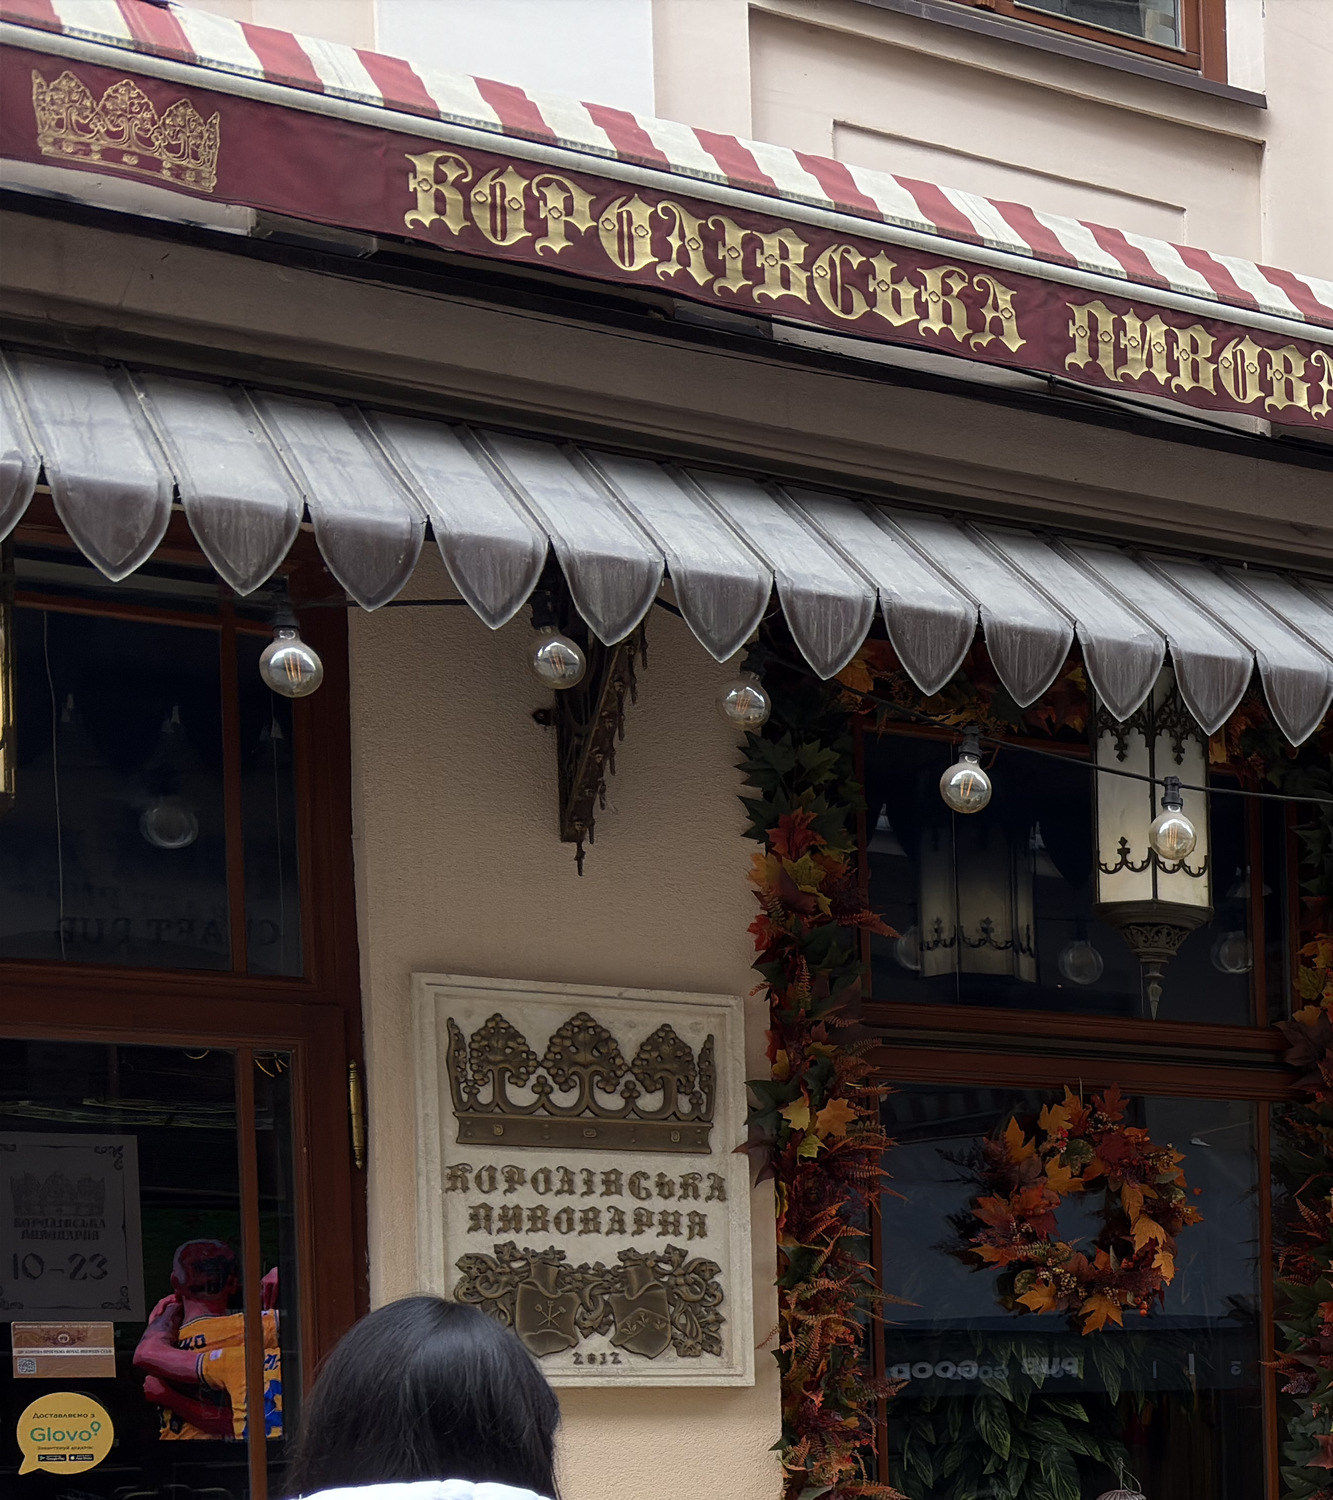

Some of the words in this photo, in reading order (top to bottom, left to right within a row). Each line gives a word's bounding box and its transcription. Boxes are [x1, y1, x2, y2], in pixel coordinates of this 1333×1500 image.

[404, 150, 1027, 353] КОРОЛІВСЬКА
[444, 1162, 728, 1204] КОРОЛІВСЬКА
[467, 1202, 708, 1241] ПИВОВАРНЯ
[30, 1427, 92, 1442] Glovo
